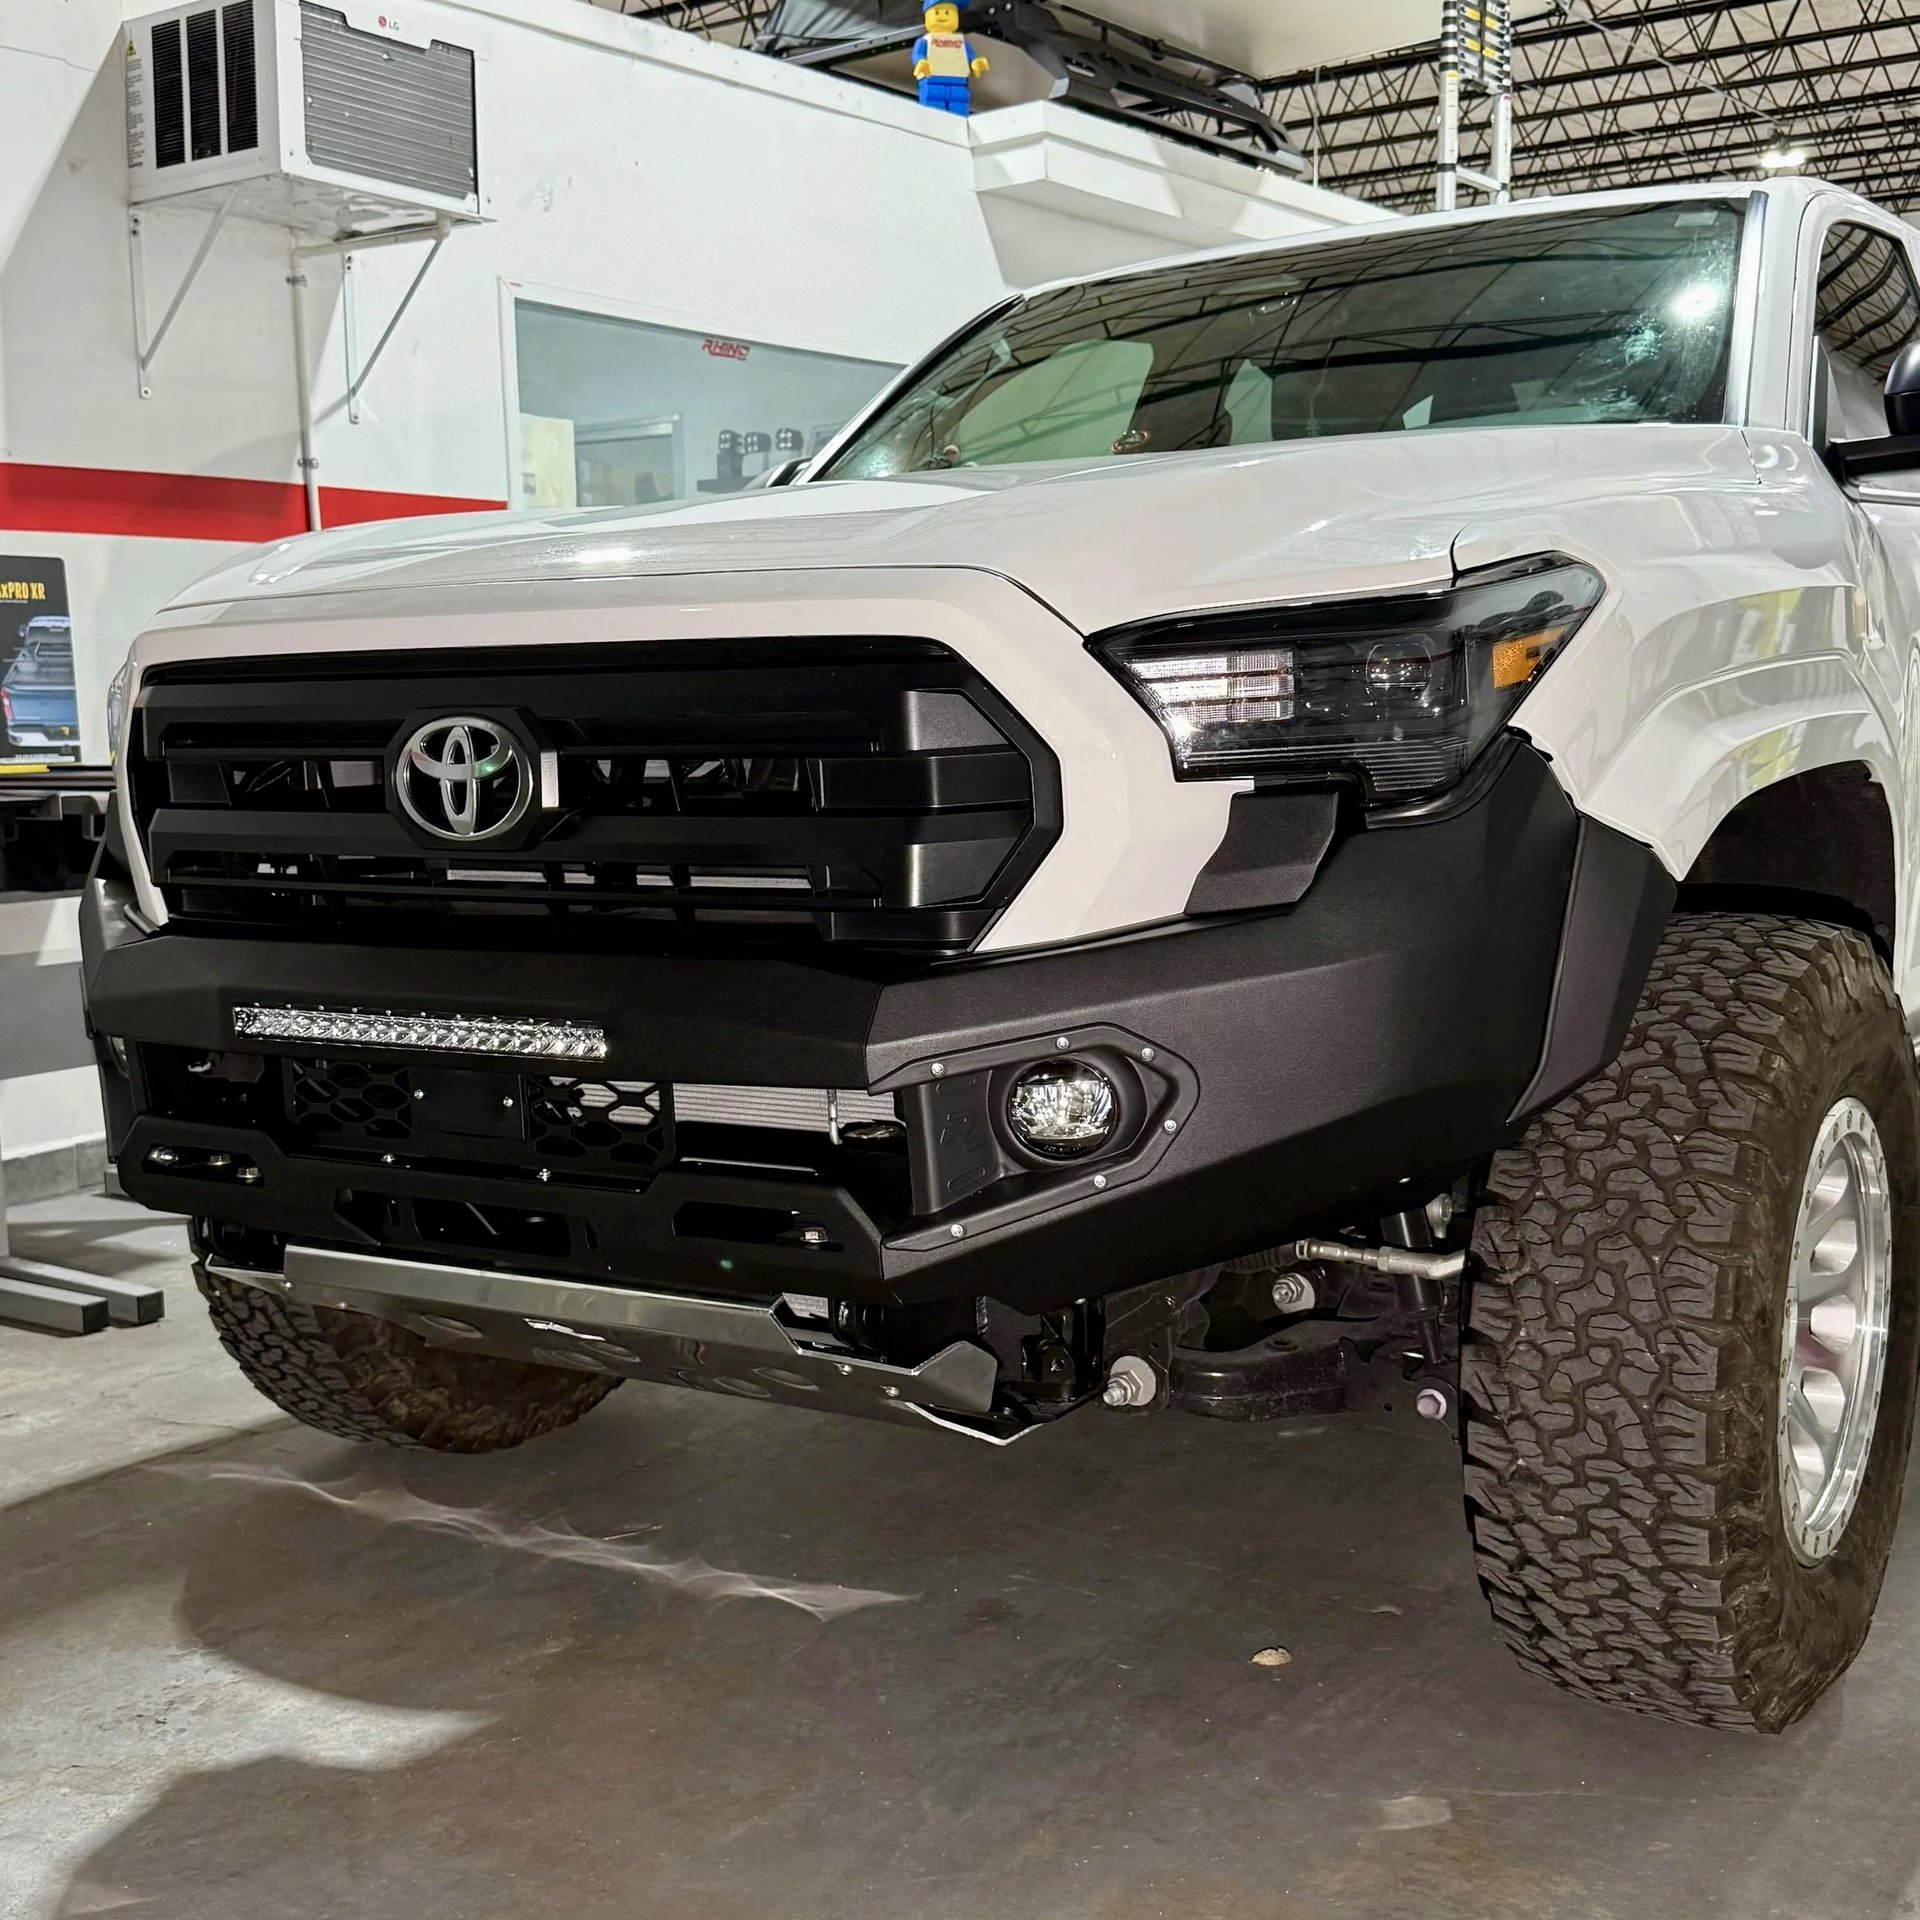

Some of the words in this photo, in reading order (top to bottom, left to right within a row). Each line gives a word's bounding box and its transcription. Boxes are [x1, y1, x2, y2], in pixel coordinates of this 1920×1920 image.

[388, 19, 400, 31] LG
[702, 338, 750, 361] RHINO
[30, 582, 46, 600] XR
